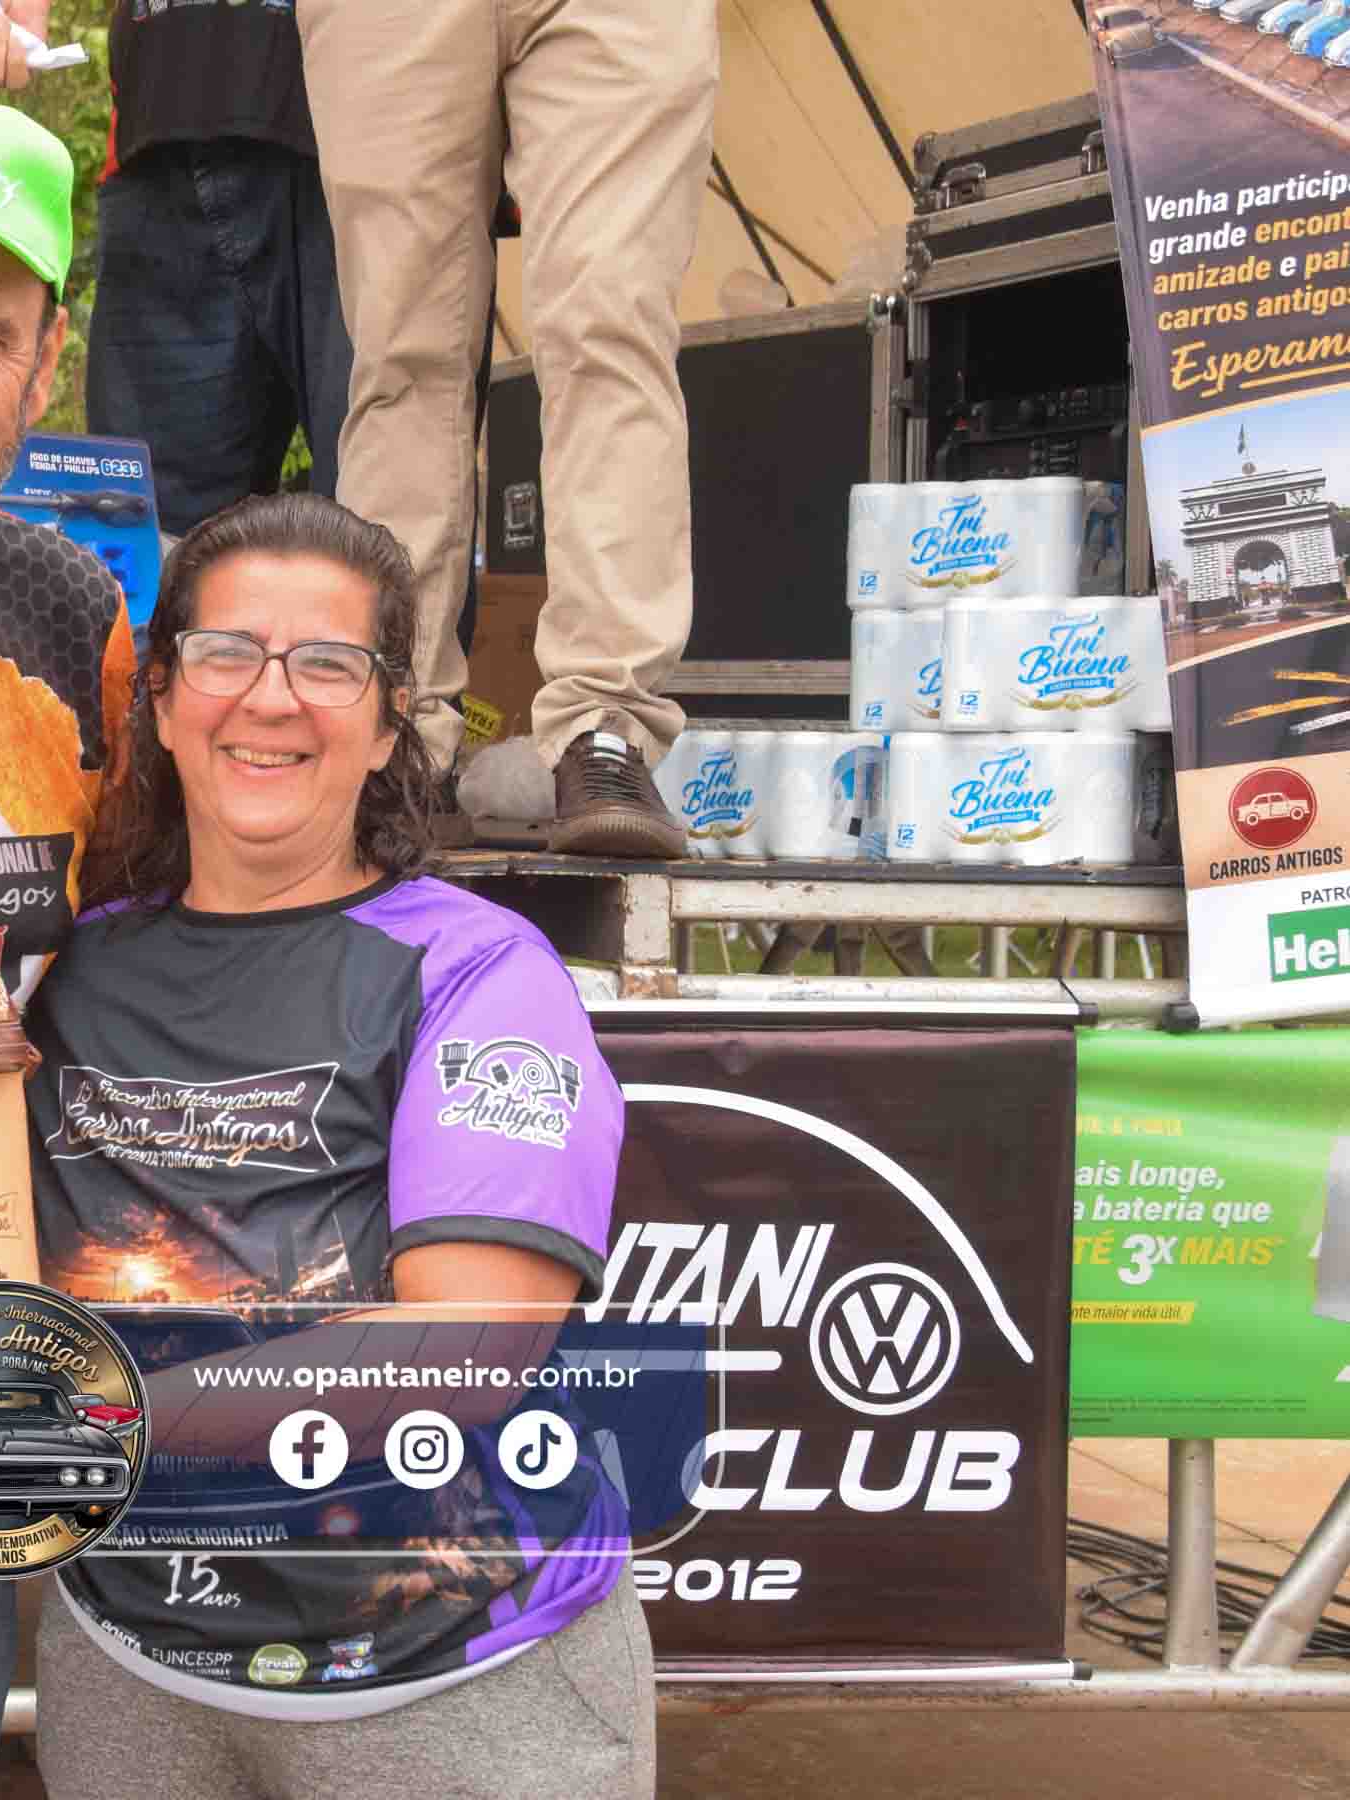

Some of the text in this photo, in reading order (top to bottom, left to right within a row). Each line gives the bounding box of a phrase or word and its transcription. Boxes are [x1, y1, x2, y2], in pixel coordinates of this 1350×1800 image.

[1145, 170, 1350, 222] Venha particip
[1149, 221, 1248, 265] grande
[1153, 242, 1350, 295] amizade e pai
[1157, 300, 1249, 331] carros
[1169, 332, 1350, 399] Esperam
[101, 459, 143, 478] 6233
[938, 497, 986, 537] Tri
[909, 527, 1009, 565] Buena
[860, 576, 877, 588] 12
[1050, 614, 1105, 656] Tri
[1017, 645, 1130, 684] Buena
[866, 705, 883, 717] 12
[961, 696, 978, 707] 12
[699, 750, 738, 791] Tri
[980, 748, 1031, 792] Tri
[682, 780, 753, 815] Buena
[951, 781, 1057, 819] Buena
[897, 828, 914, 840] 12
[1209, 846, 1343, 881] CARROS ANTIGOS
[173, 1081, 306, 1111] Internacional
[442, 1087, 564, 1136] Antigões
[1074, 1160, 1226, 1191] ais longe,
[1092, 1194, 1205, 1221] bateria
[1212, 1201, 1272, 1228] que
[1073, 1229, 1114, 1264] TÉ
[1093, 1304, 1131, 1319] maior
[1133, 1303, 1159, 1318] vida
[681, 1430, 1021, 1511] CLUB
[151, 1522, 289, 1547] COMEMORATIVA
[164, 1552, 242, 1608] 15 anos
[633, 1560, 801, 1601] 2012
[151, 1648, 233, 1666] FUNCESPP
